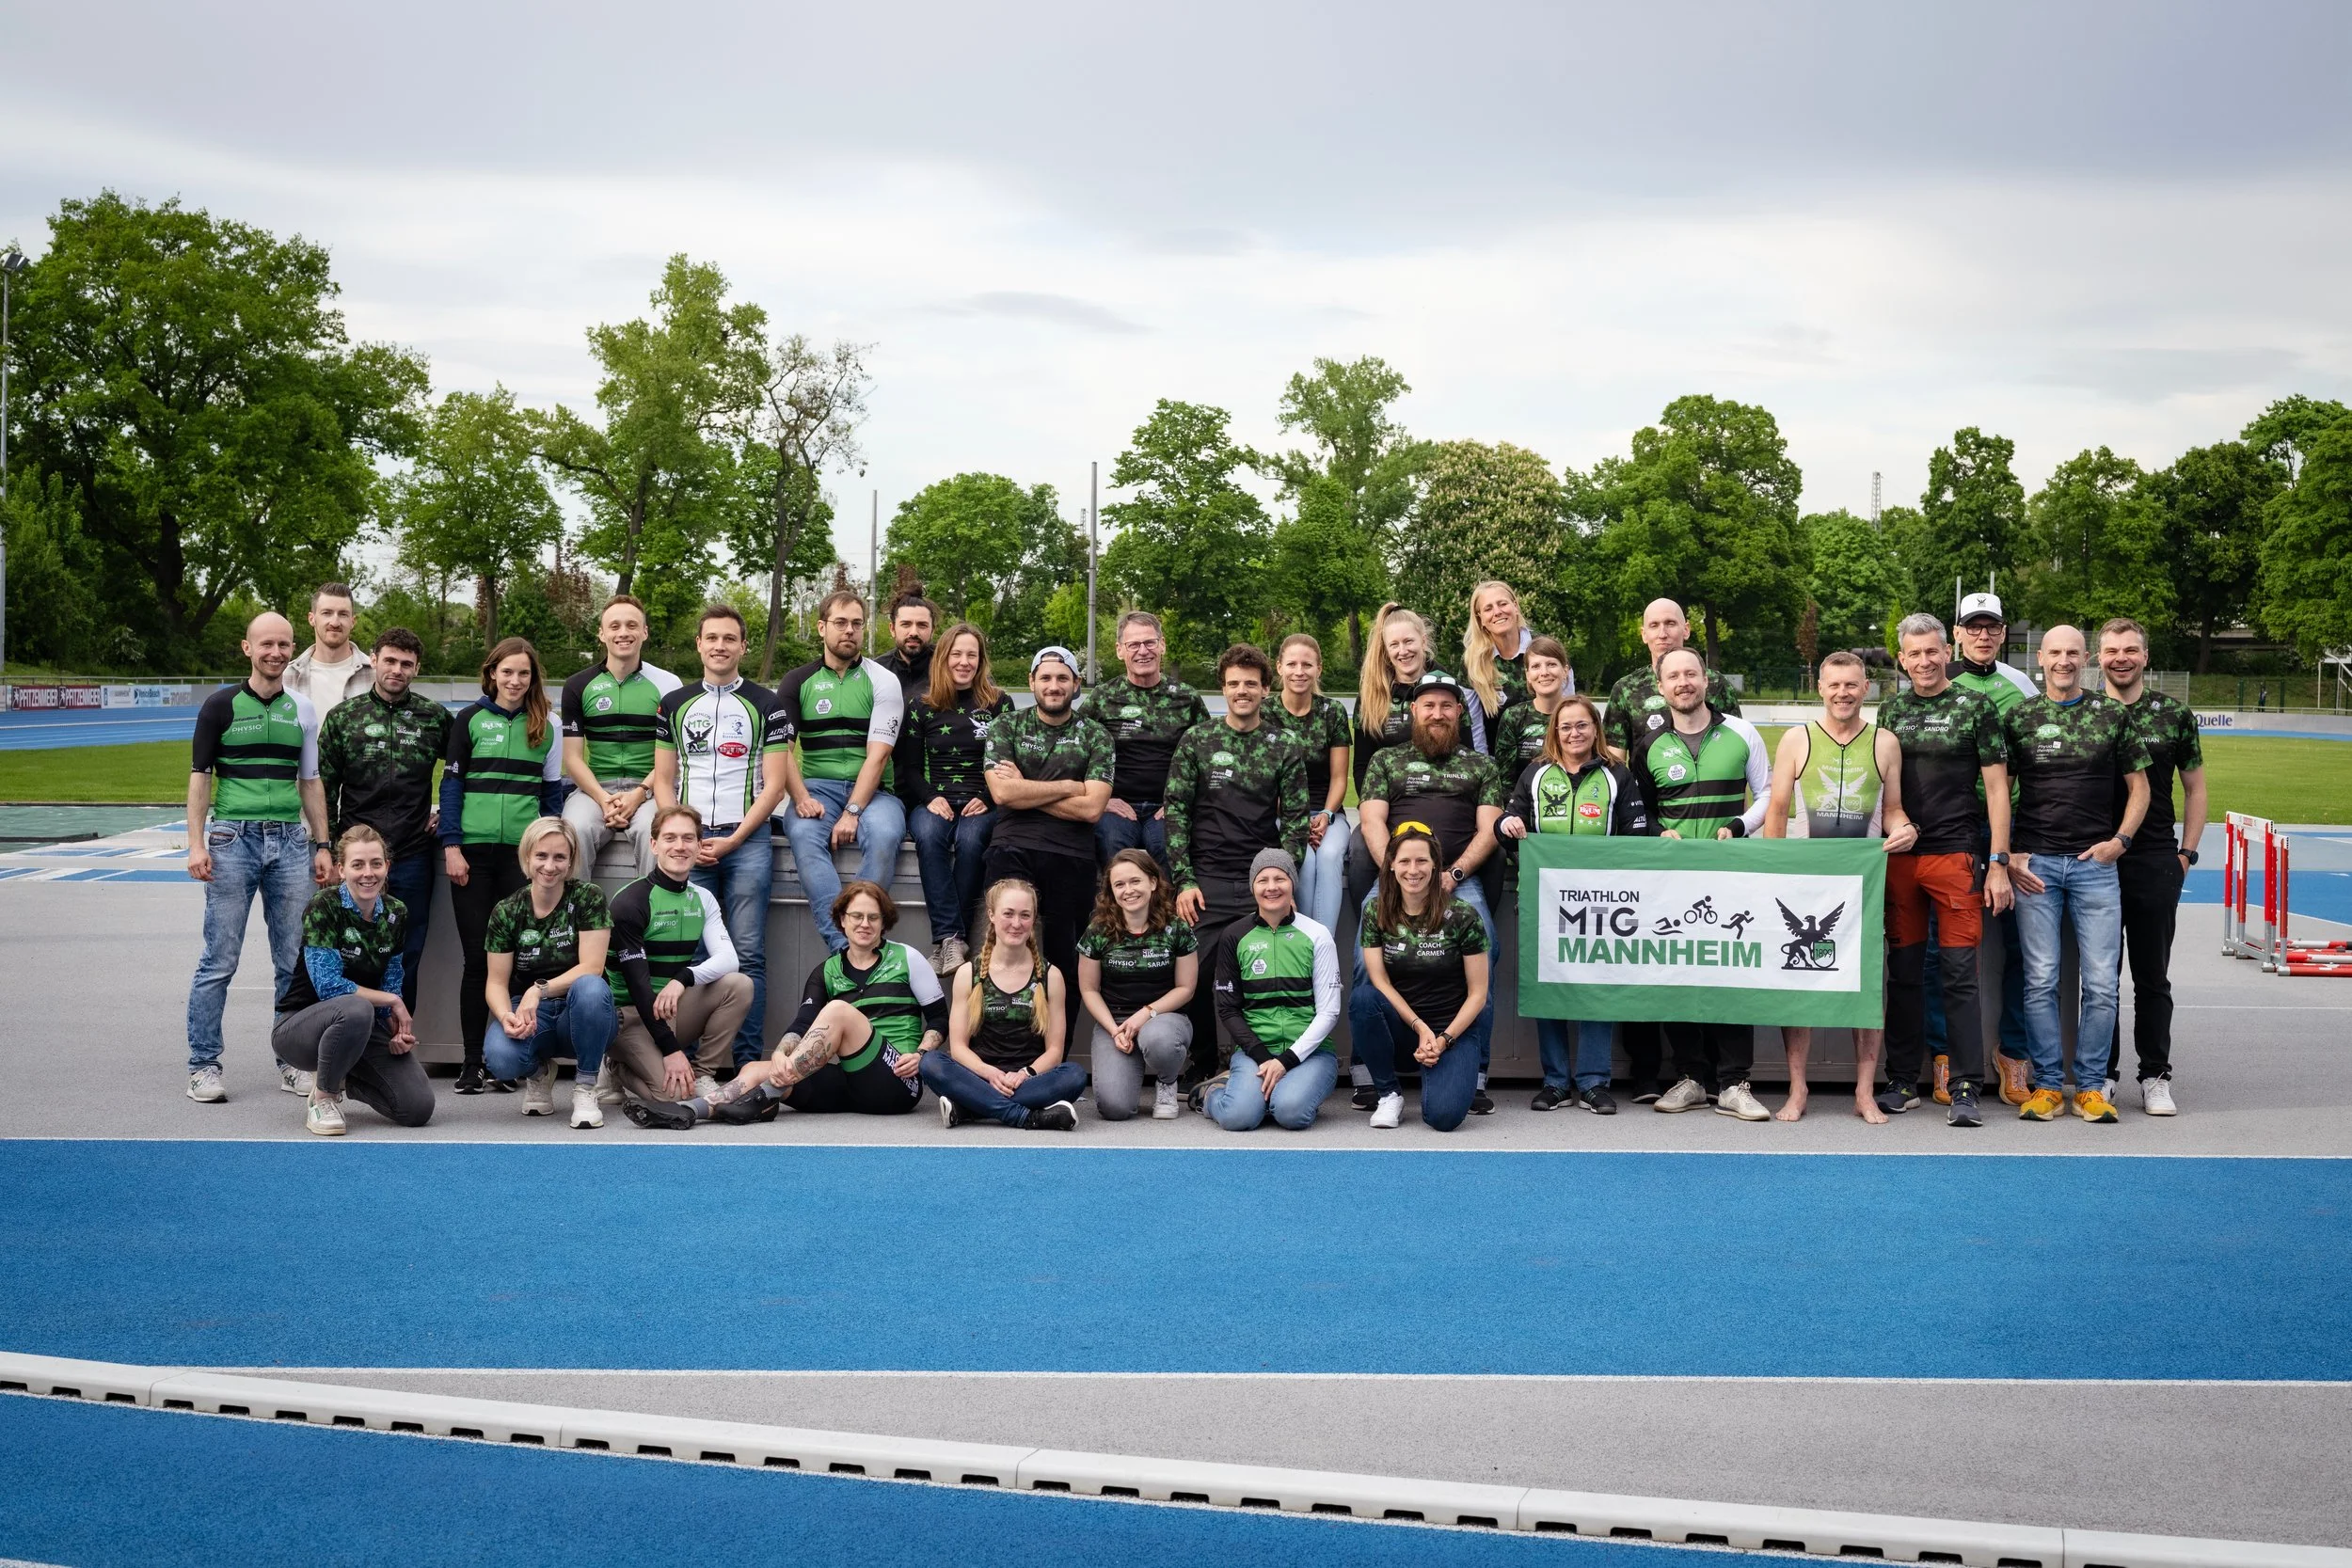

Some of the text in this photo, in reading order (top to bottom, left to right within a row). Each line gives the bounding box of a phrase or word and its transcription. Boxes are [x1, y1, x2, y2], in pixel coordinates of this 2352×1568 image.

[688, 720, 711, 728] MTG
[2195, 713, 2233, 727] Quelle
[1817, 812, 1864, 820] MANNHEIM
[1559, 890, 1640, 903] TRIATHLON
[1558, 905, 1639, 937] MTG
[557, 940, 571, 948] SINA
[1558, 937, 1762, 968] MANNHEIM
[1815, 948, 1834, 958] 1899
[1147, 959, 1169, 968] SARAH
